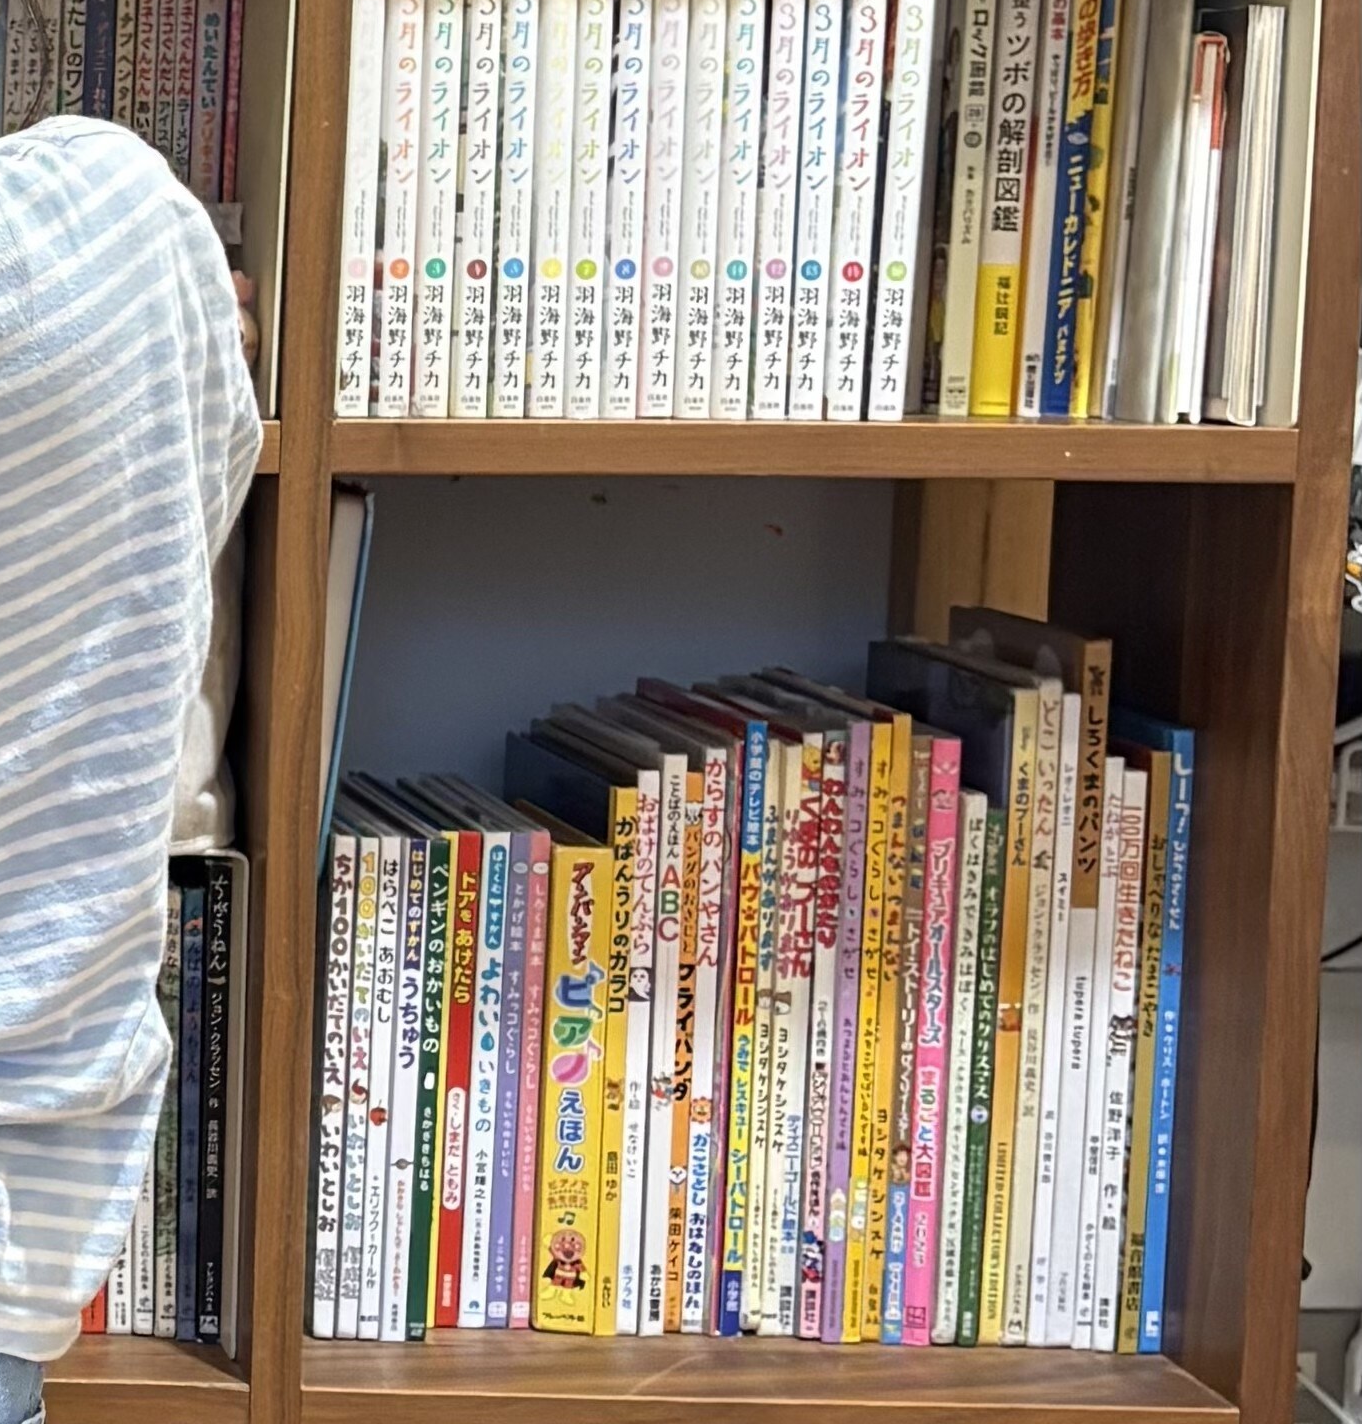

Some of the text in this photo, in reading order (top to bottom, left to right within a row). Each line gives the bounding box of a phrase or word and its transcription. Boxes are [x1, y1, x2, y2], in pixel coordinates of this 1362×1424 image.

[769, 2, 796, 188] 3月のライオン
[806, 3, 833, 190] 3月のライオン
[847, 5, 876, 191] 3月のライオン
[892, 4, 924, 191] 3月のライオン
[991, 36, 1031, 232] ツボの解剖図鑑
[1058, 155, 1083, 319] ニューカレドニア
[345, 285, 366, 388] 羽海野チカ
[387, 284, 408, 388] 羽海野チカ
[423, 284, 444, 388] 羽海野チカ
[464, 285, 486, 389] 羽海野チカ
[502, 284, 523, 388] 羽海野チカ
[539, 284, 560, 389] 羽海野チカ
[574, 285, 595, 390] 羽海野チカ
[613, 285, 634, 389] 羽海野チカ
[651, 283, 672, 387] 羽海野チカ
[688, 286, 709, 390] 羽海野チカ
[724, 286, 745, 390] 羽海野チカ
[763, 285, 784, 390] 羽海野チカ
[797, 287, 819, 391] 羽海野チカ
[838, 288, 861, 392] 羽海野チカ
[880, 288, 904, 392] 羽海野チカ
[1011, 763, 1030, 867] くまのプーさん
[1076, 705, 1105, 873] しろくまのパンツ
[458, 872, 477, 923] ドアを
[608, 816, 634, 1013] かばんうりのガラゴ
[632, 792, 659, 955] おばけのてんぷら
[658, 864, 681, 942] ABC
[791, 795, 822, 979] くまのプーさん
[816, 777, 846, 950] わんわんものがたり
[210, 875, 229, 971] ちがうねん
[323, 853, 353, 1086] ちか100かいだてのいえ
[352, 851, 376, 1072] 100かいだてのいえ
[376, 859, 398, 1024] はらぺこ あおむし
[399, 850, 425, 1070] はじめてのずかん うちゅう
[422, 865, 449, 1054] ペンギンのおかいもの
[454, 928, 474, 1004] あけたら
[920, 839, 954, 1048] プリキュアオールスターズ
[479, 957, 502, 1026] よわい
[505, 971, 522, 1075] すみっコぐらし
[524, 985, 540, 1090] すみっコぐらし
[673, 965, 696, 1102] フライパンダ
[685, 757, 725, 1310] からすのパンやさん かこさとし おはなしのほん
[973, 886, 1001, 1099] オラフのはじめてのクリスマス
[475, 1058, 496, 1133] いきもの
[754, 1023, 771, 1149] ヨシタケシンスケ
[771, 1027, 789, 1155] ヨシタケシンスケ
[1071, 1025, 1085, 1070] tupera
[343, 1113, 366, 1232] いわいとしお
[555, 1088, 585, 1174] えほん
[1105, 1090, 1124, 1162] 佐野洋子
[318, 1125, 340, 1233] いわいとしお
[726, 1148, 748, 1265] シーパトロール
[869, 1108, 889, 1260] ヨシタケシンスケ
